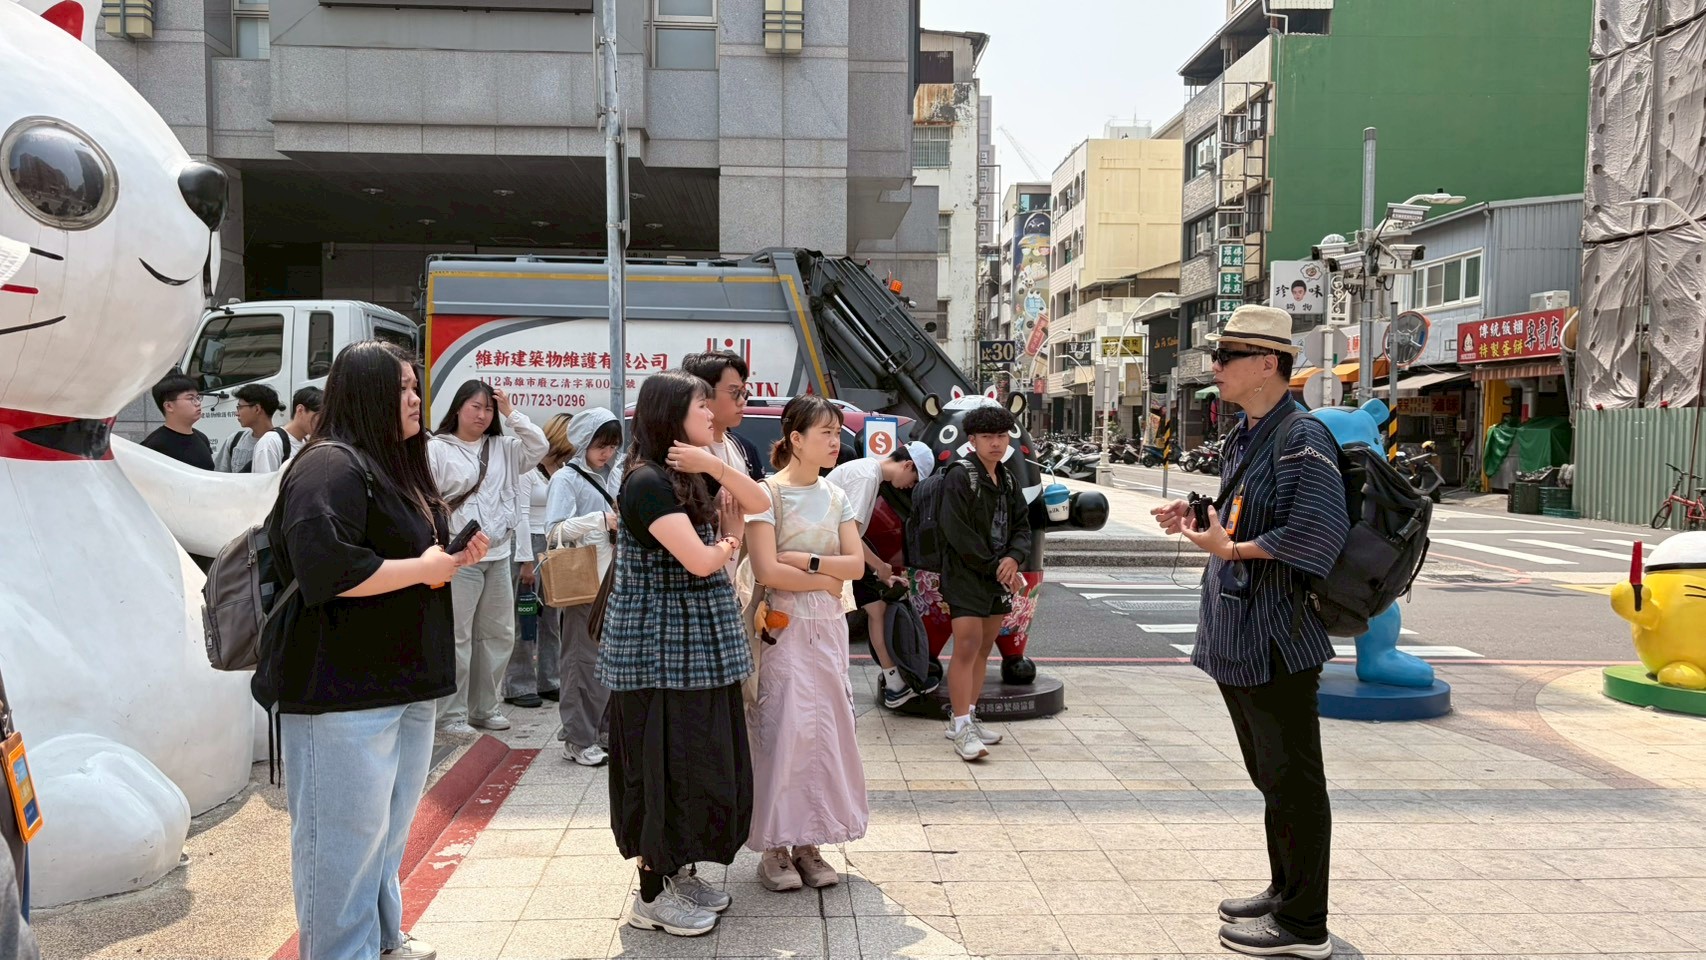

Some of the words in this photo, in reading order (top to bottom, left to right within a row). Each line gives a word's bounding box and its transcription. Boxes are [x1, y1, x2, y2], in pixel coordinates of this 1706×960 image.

[1232, 274, 1242, 293] 文具
[1525, 316, 1560, 351] 專賣店
[1479, 339, 1523, 358] 特製蛋餅
[479, 376, 636, 390] 112高雄市廢乙清字第00號
